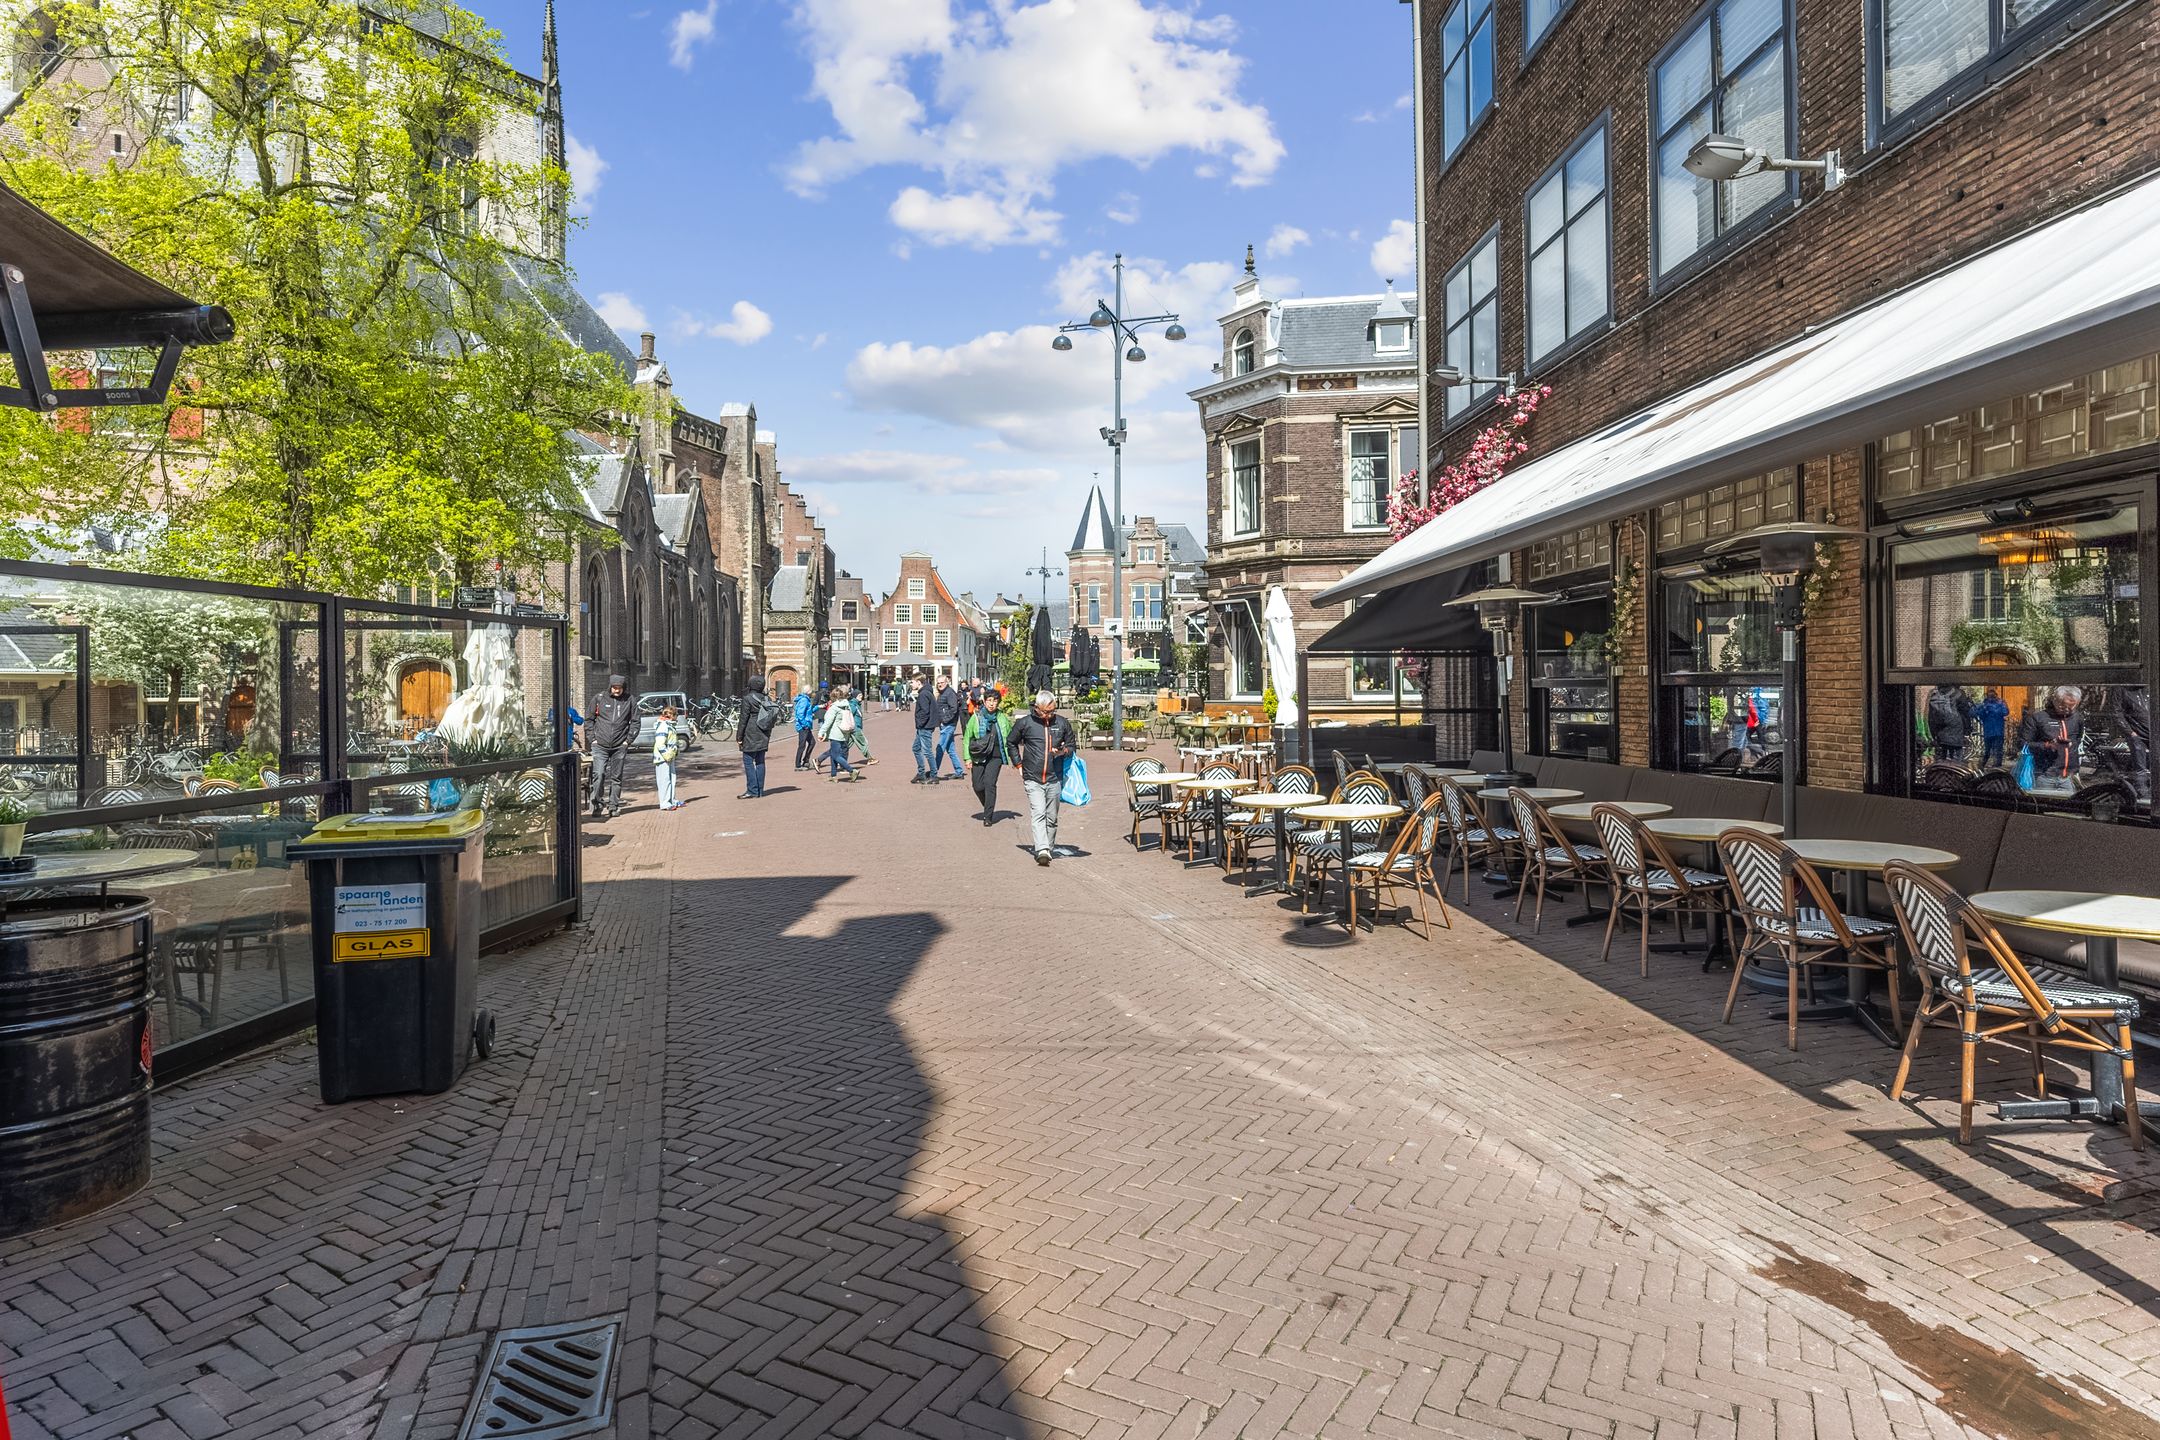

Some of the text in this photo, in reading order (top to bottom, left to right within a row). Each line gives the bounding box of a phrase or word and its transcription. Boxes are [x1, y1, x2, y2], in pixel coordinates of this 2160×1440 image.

[339, 890, 391, 901] spaarne
[380, 896, 423, 906] landen
[394, 918, 407, 926] 200
[351, 939, 413, 951] GLAS
